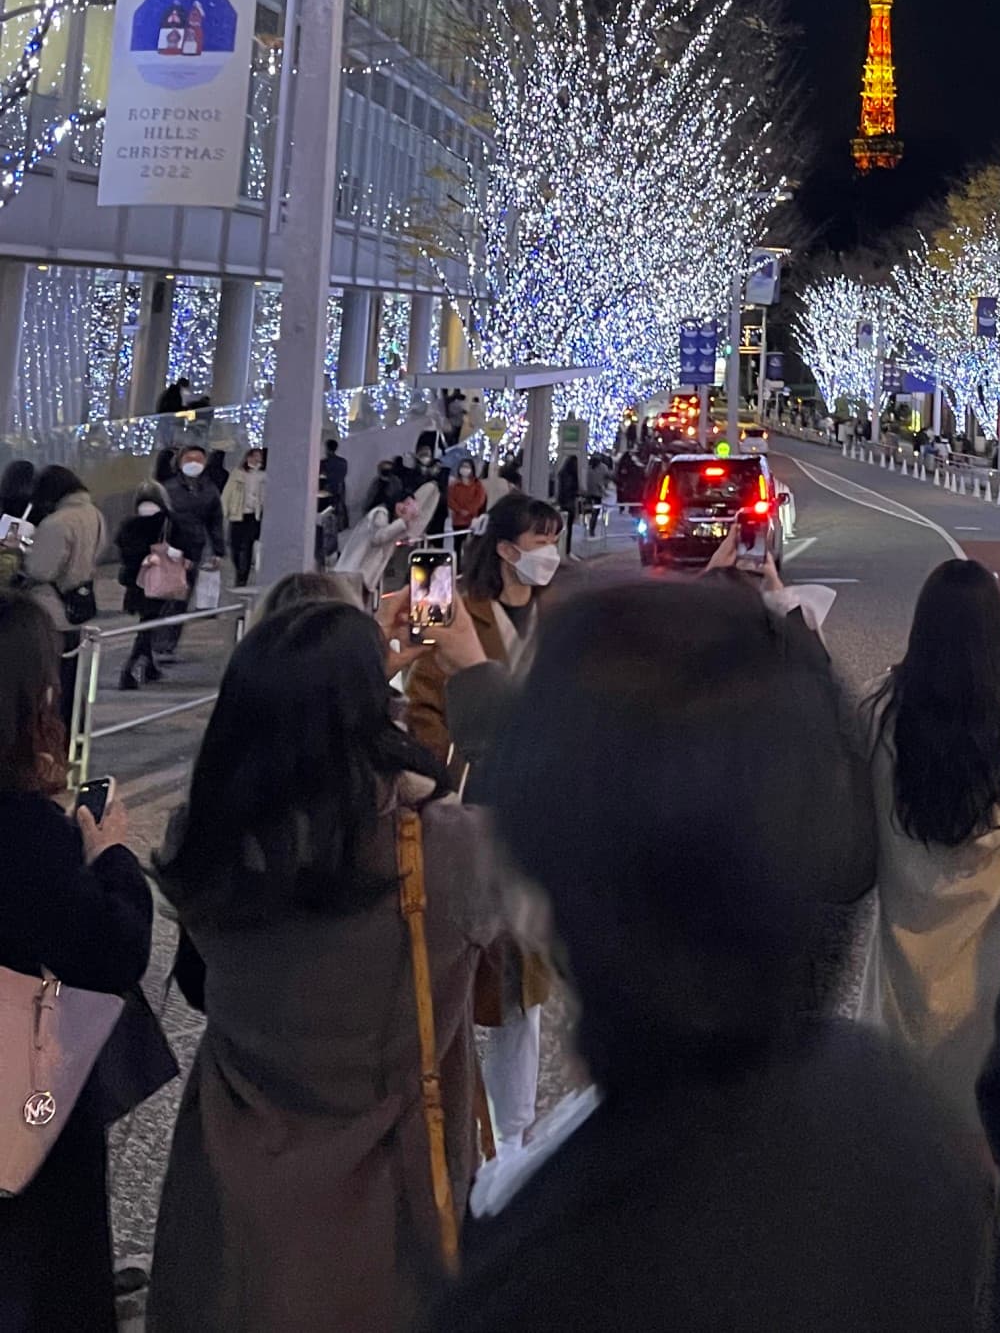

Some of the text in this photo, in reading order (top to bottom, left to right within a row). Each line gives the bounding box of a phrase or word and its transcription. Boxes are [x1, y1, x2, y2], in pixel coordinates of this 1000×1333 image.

[144, 127, 200, 140] HILLS
[116, 145, 226, 161] CHRISTMAS
[140, 165, 192, 179] 2022
